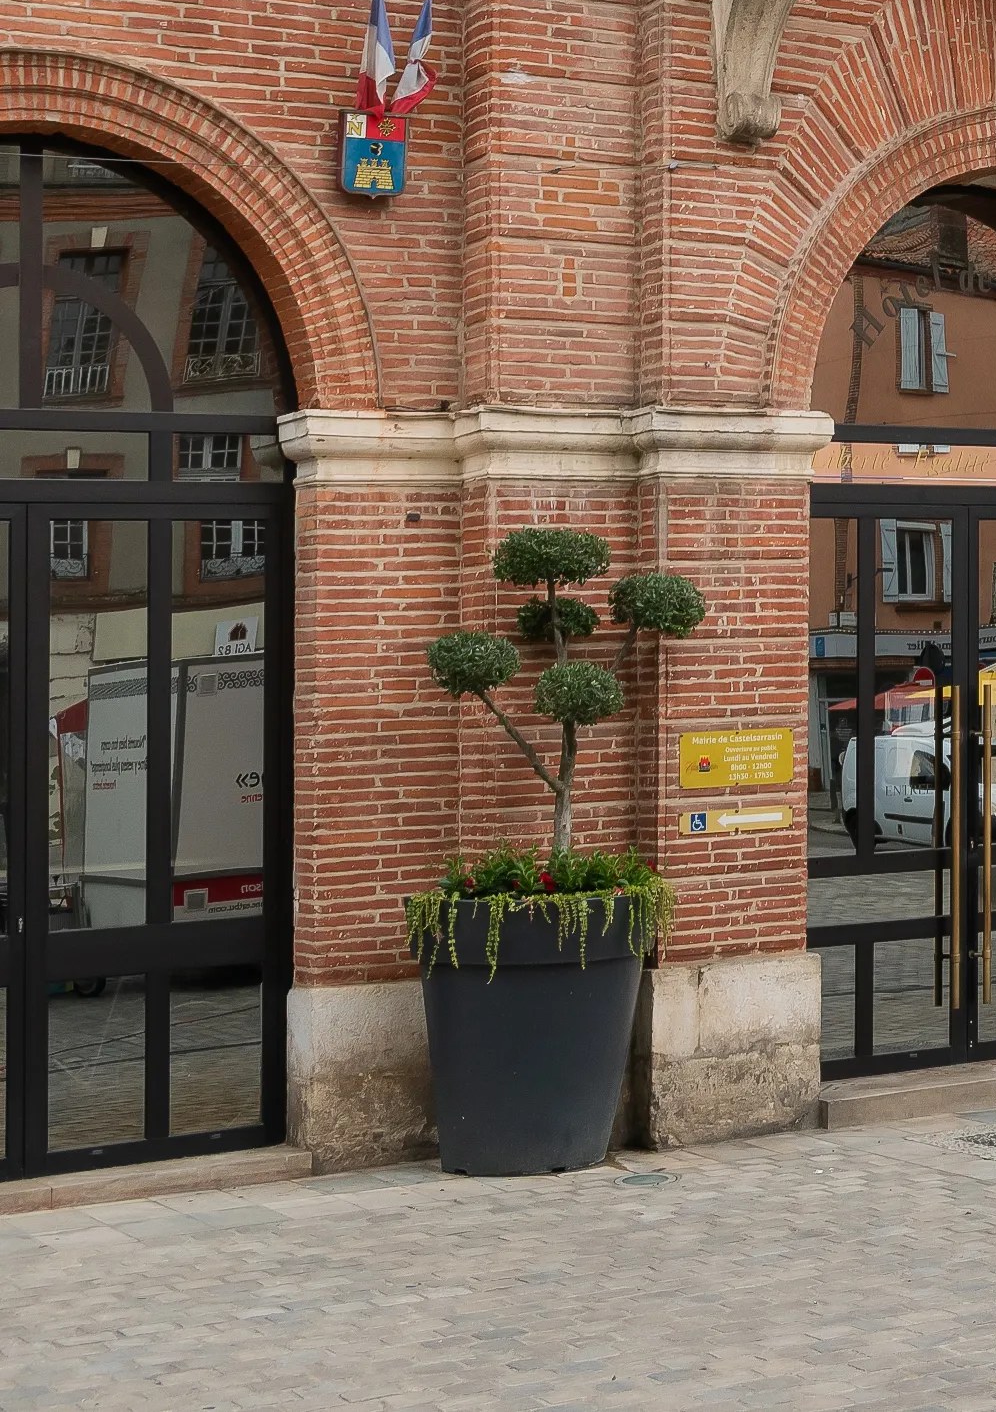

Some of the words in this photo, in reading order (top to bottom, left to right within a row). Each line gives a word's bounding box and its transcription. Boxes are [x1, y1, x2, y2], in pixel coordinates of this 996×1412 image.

[347, 121, 363, 136] N
[849, 248, 942, 350] Hôtel
[811, 445, 891, 470] Liberté
[692, 736, 716, 745] Mairie
[718, 735, 728, 744] de
[729, 732, 783, 743] Castelsarrasin
[723, 754, 741, 762] Lundi
[750, 752, 779, 761] Vendredi
[752, 762, 772, 770] 12h00
[729, 773, 749, 781] 13h30
[754, 772, 774, 780] 17h30
